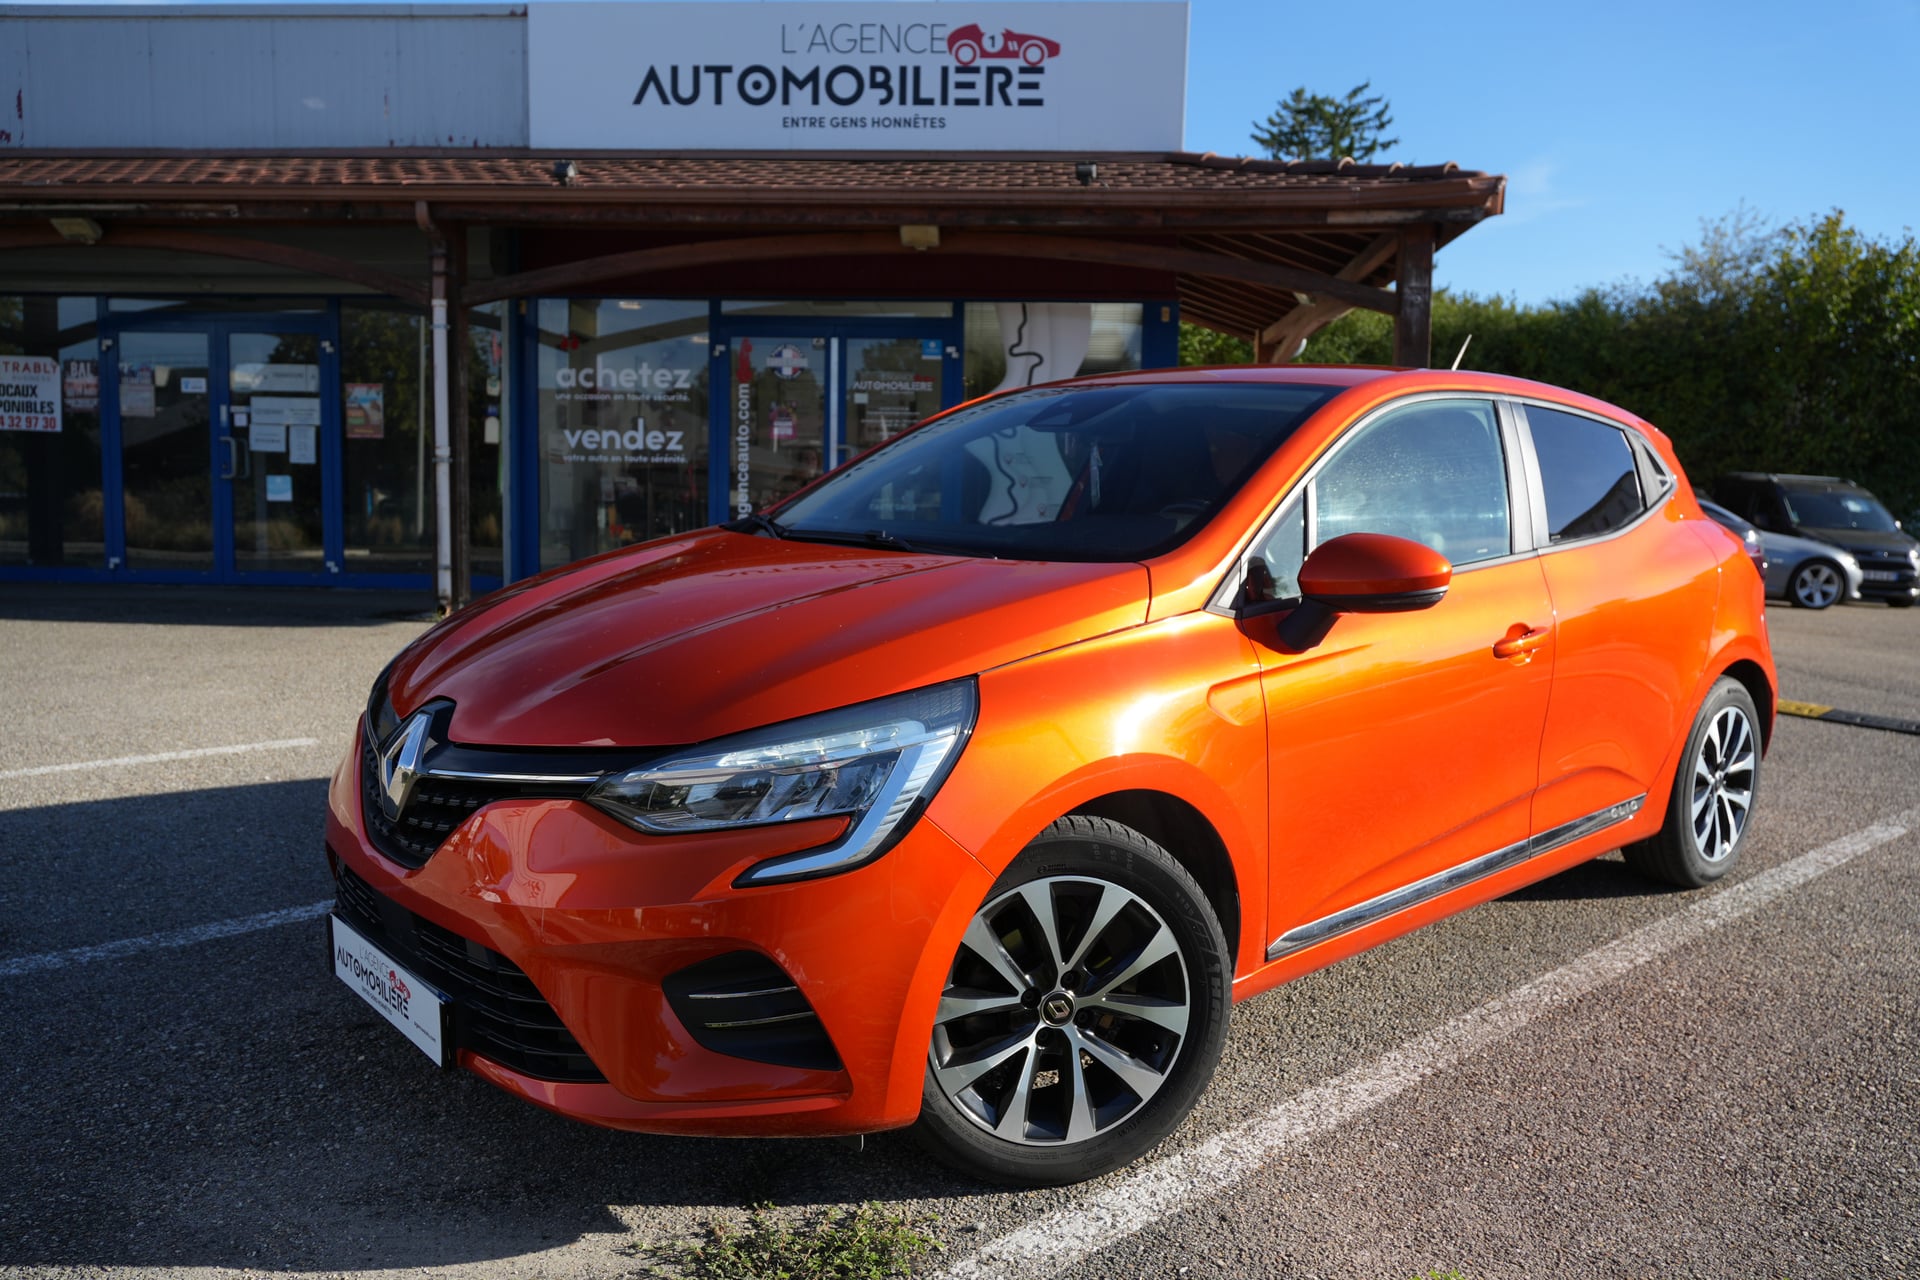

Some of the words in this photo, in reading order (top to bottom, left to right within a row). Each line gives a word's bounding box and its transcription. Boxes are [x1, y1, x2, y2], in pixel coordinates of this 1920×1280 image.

[987, 34, 997, 48] 1
[782, 117, 826, 128] ENTRE
[829, 117, 868, 128] GENS
[871, 114, 947, 129] HONNÊTES
[556, 353, 691, 389] achetez
[554, 393, 571, 401] une
[573, 393, 611, 401] occasion
[612, 393, 625, 401] en
[627, 392, 650, 401] toute
[8, 415, 22, 428] 32
[25, 416, 39, 428] 97
[42, 416, 57, 430] 30
[563, 417, 685, 451] vendez
[587, 454, 609, 463] auto
[611, 455, 622, 463] en
[624, 454, 648, 463] toute
[1610, 800, 1638, 818] CLIO
